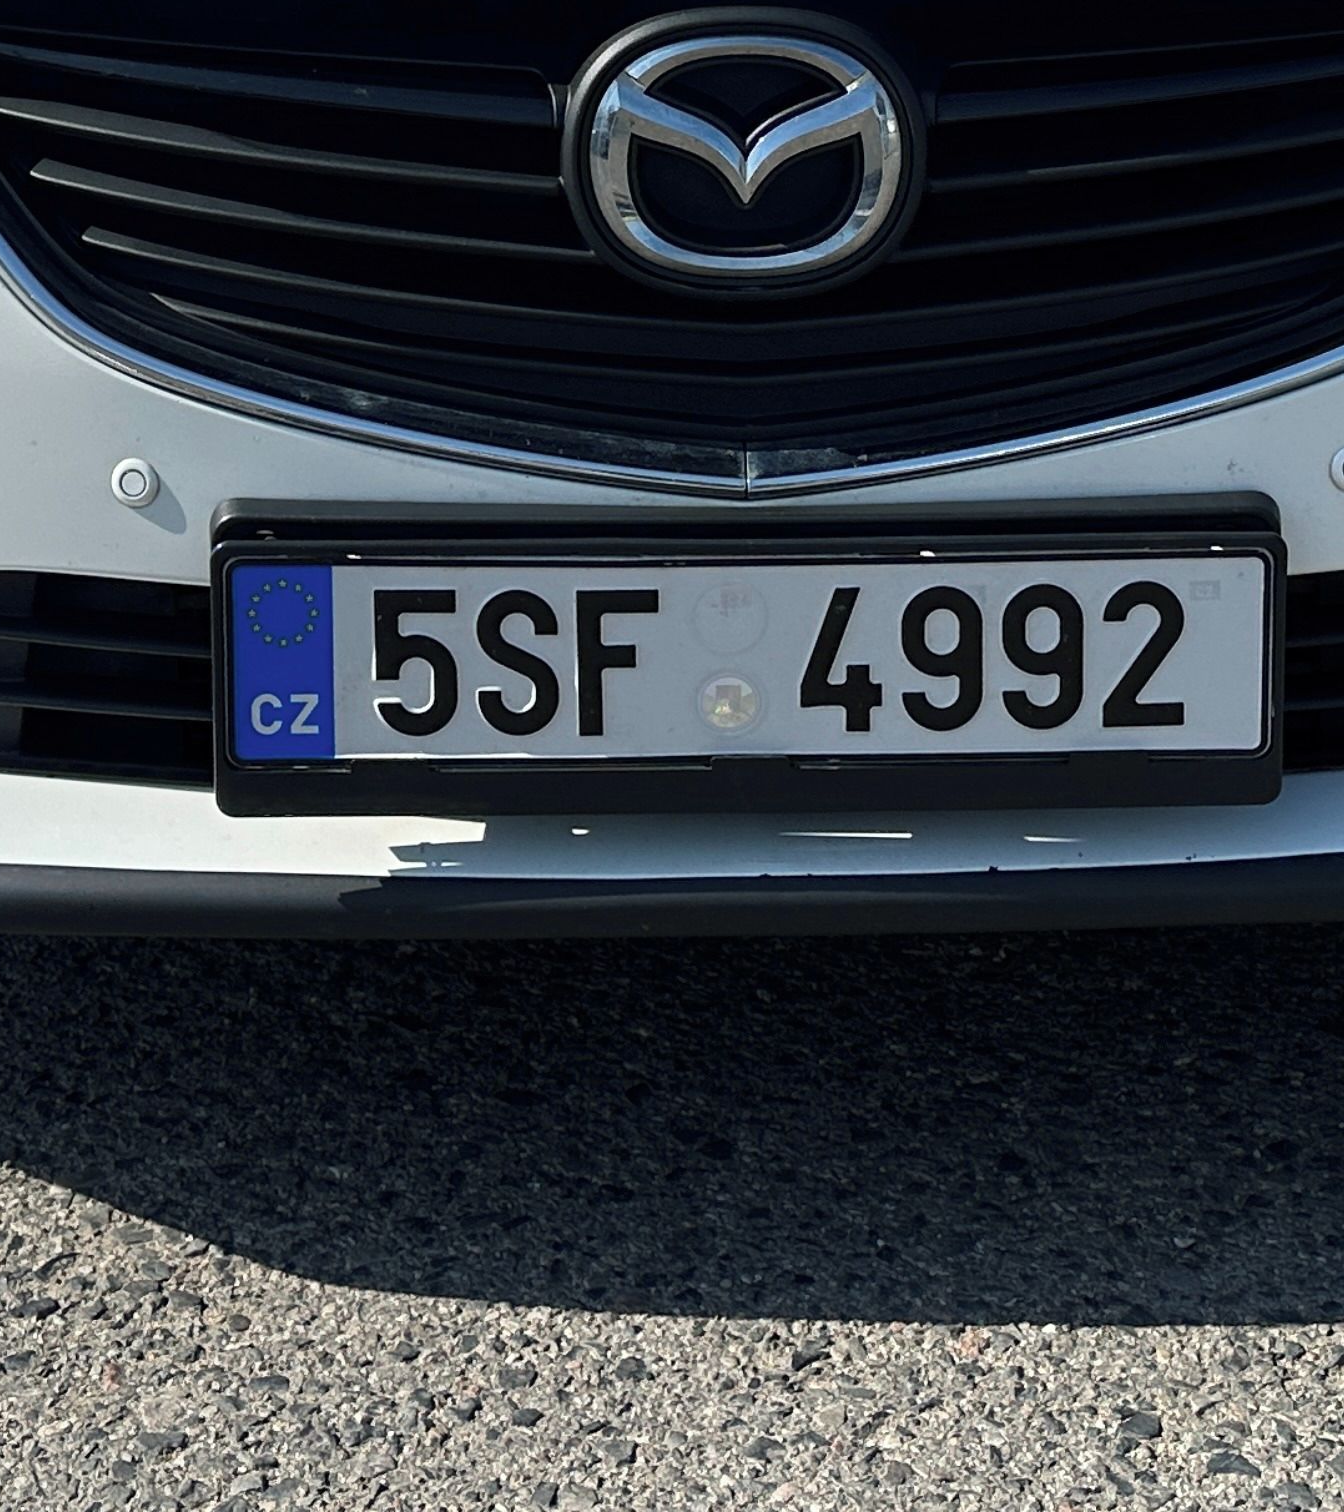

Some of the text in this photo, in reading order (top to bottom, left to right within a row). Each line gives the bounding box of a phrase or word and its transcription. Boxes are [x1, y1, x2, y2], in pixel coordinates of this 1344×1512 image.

[372, 580, 1186, 737] 5SF 4992
[250, 693, 321, 736] CZ
